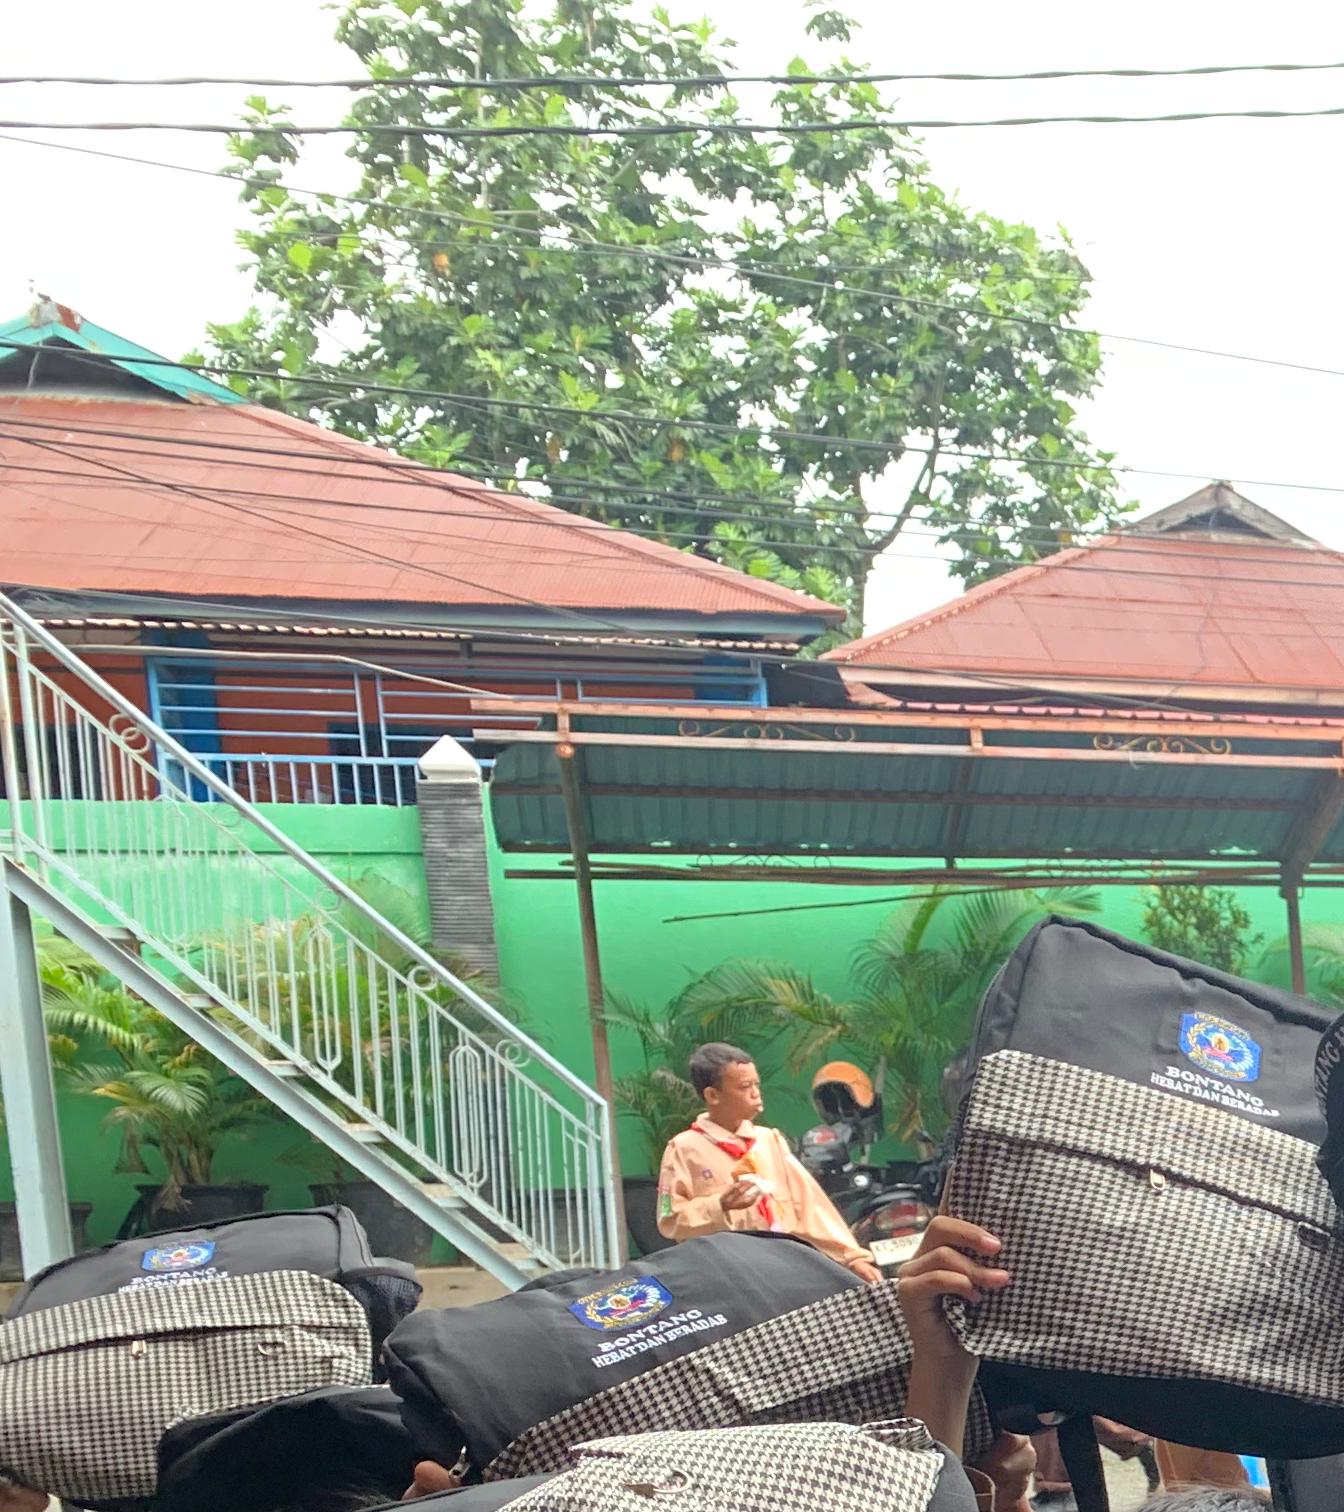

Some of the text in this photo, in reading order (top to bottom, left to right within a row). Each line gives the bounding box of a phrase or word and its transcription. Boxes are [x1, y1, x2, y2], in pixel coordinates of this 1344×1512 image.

[1151, 1071, 1280, 1117] HEBAT DAN BERADAB
[1165, 1066, 1264, 1107] BONTANG
[131, 1267, 217, 1285] BONTANG
[592, 1314, 728, 1369] HEBAT DAN BERADAB
[598, 1309, 703, 1353] BONTANG
